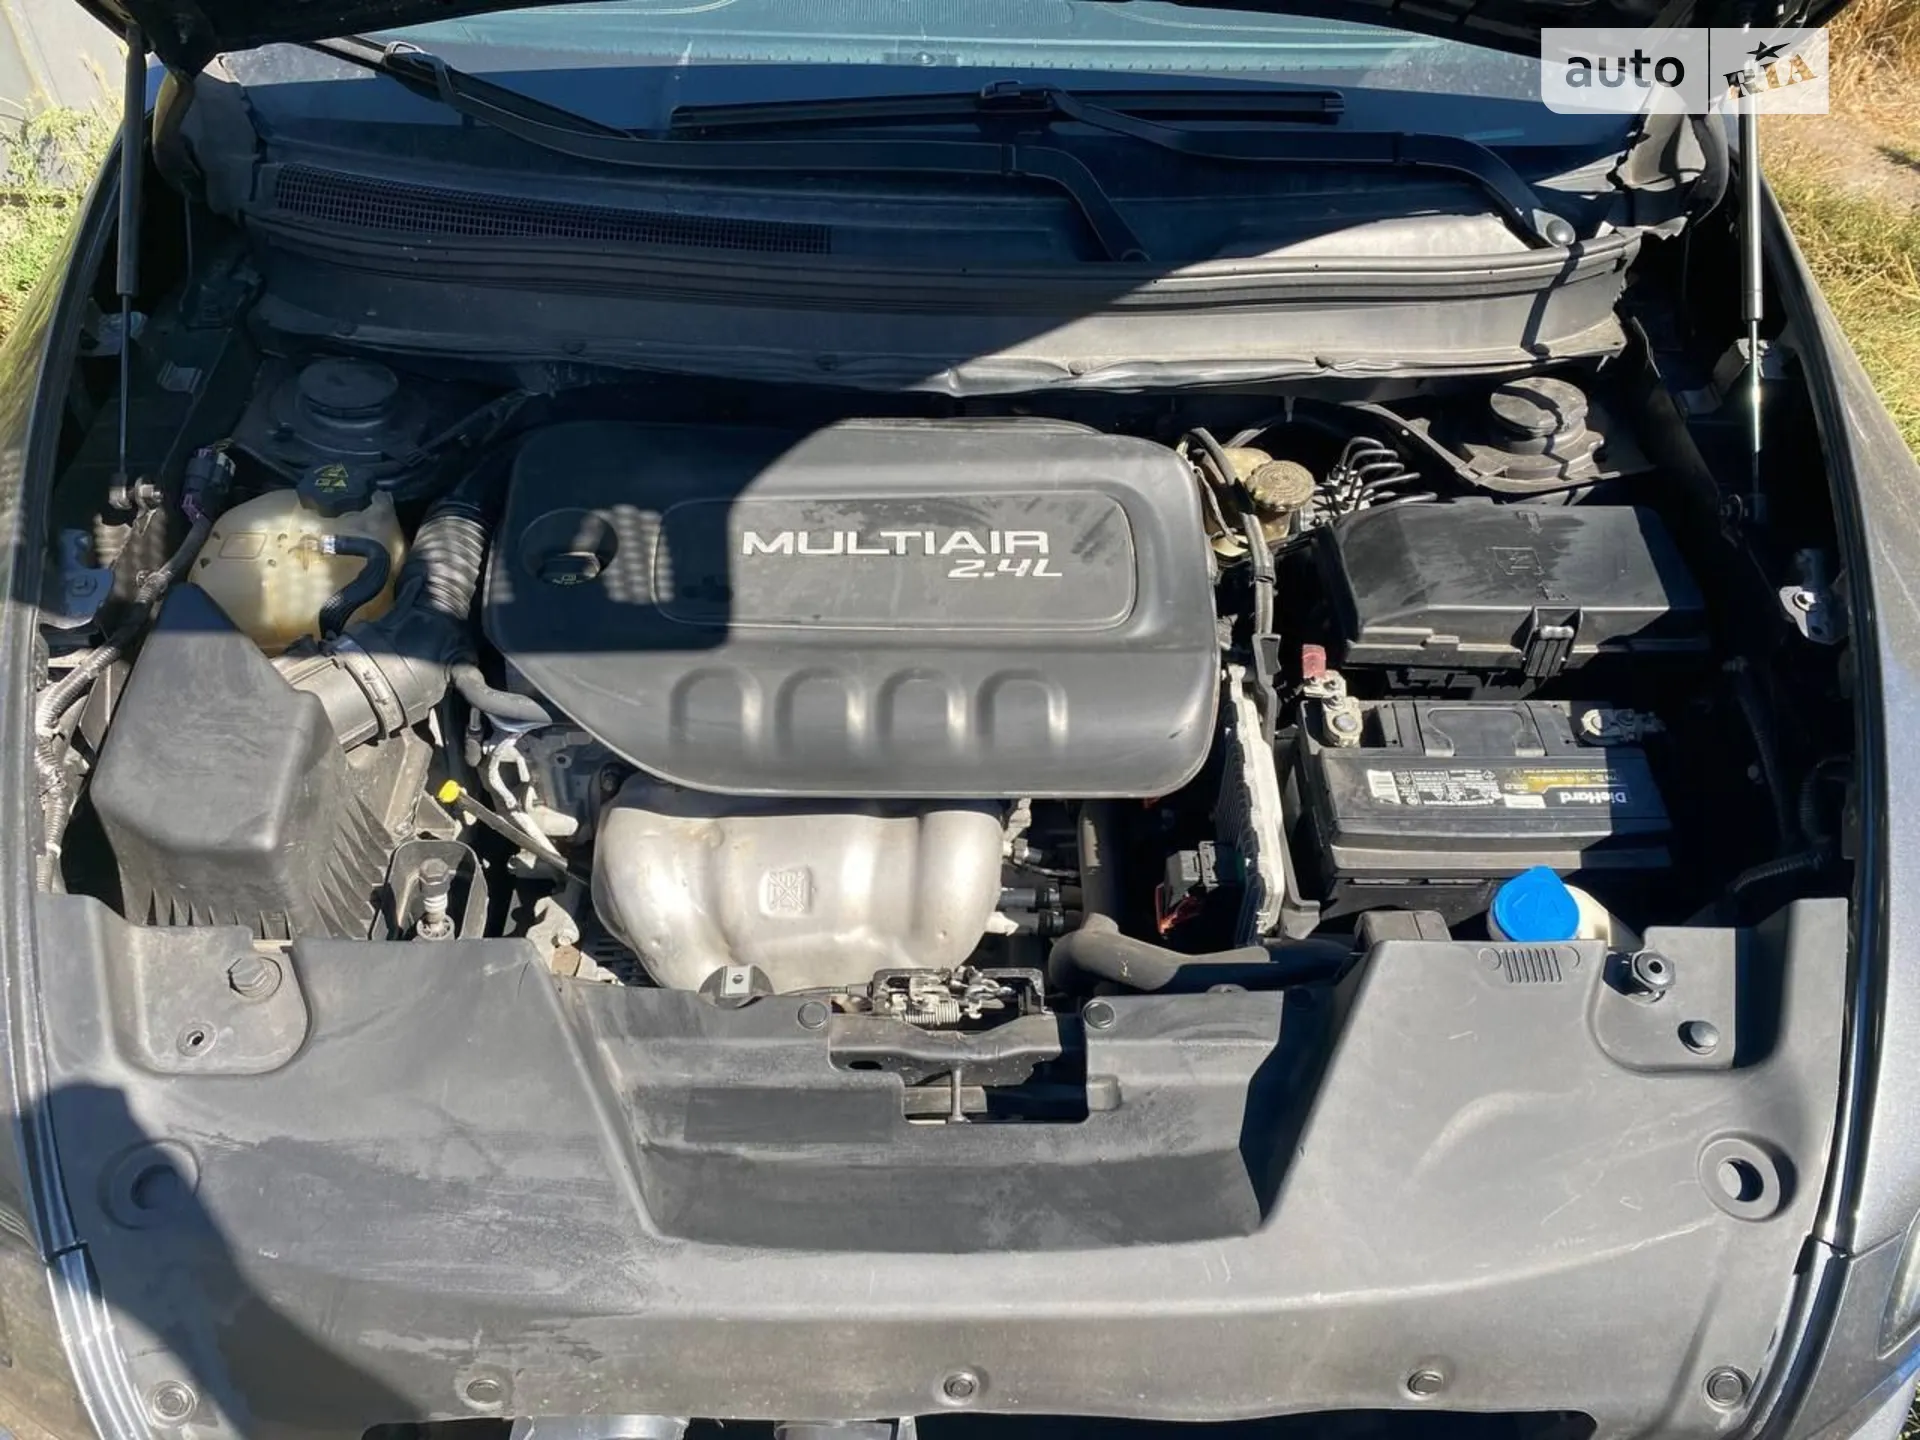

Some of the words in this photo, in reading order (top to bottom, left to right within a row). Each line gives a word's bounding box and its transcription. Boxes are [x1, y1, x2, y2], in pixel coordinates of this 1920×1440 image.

[742, 530, 1050, 556] MULTIAIR
[947, 559, 1063, 578] 2.4L
[1559, 791, 1627, 804] DieHard
